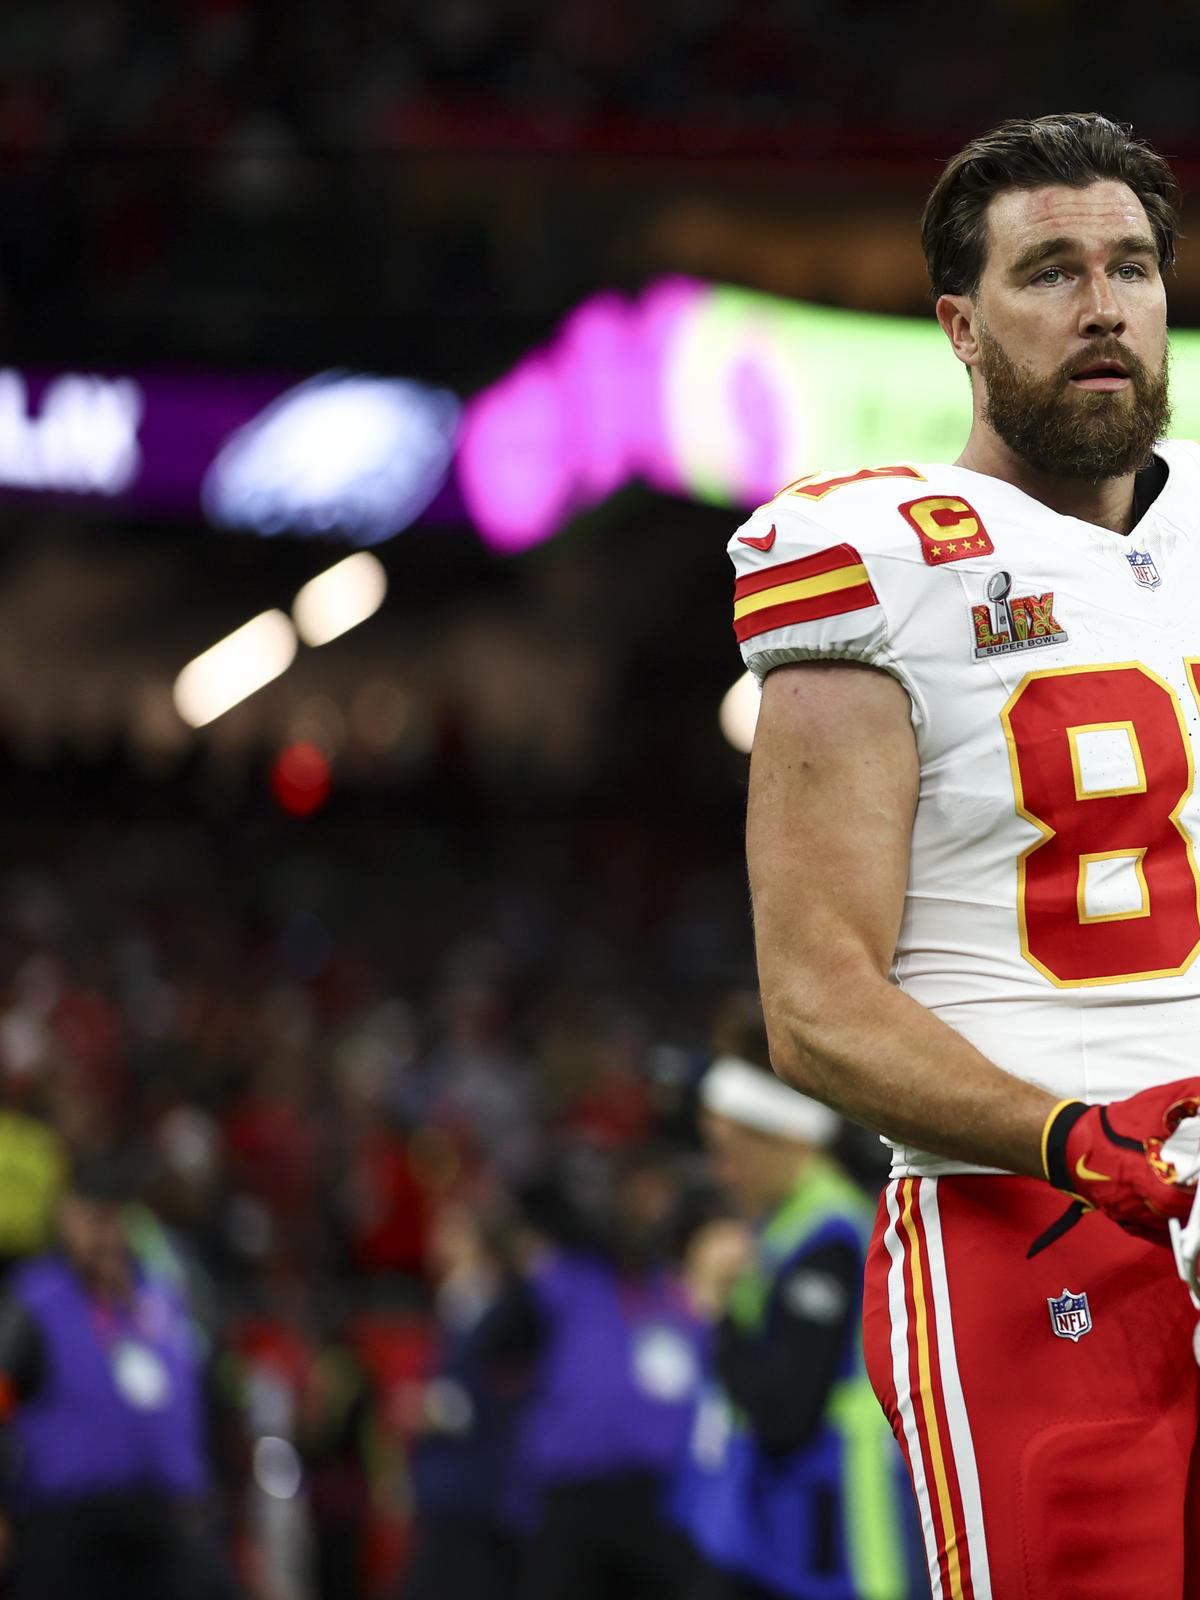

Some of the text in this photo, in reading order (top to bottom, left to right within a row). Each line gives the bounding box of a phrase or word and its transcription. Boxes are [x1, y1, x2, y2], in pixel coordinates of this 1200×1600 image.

[909, 498, 979, 542] C
[1134, 566, 1157, 582] NFL
[971, 592, 1065, 649] LIX
[986, 635, 1059, 655] SUPER BOWL
[1056, 1311, 1086, 1332] NFL
